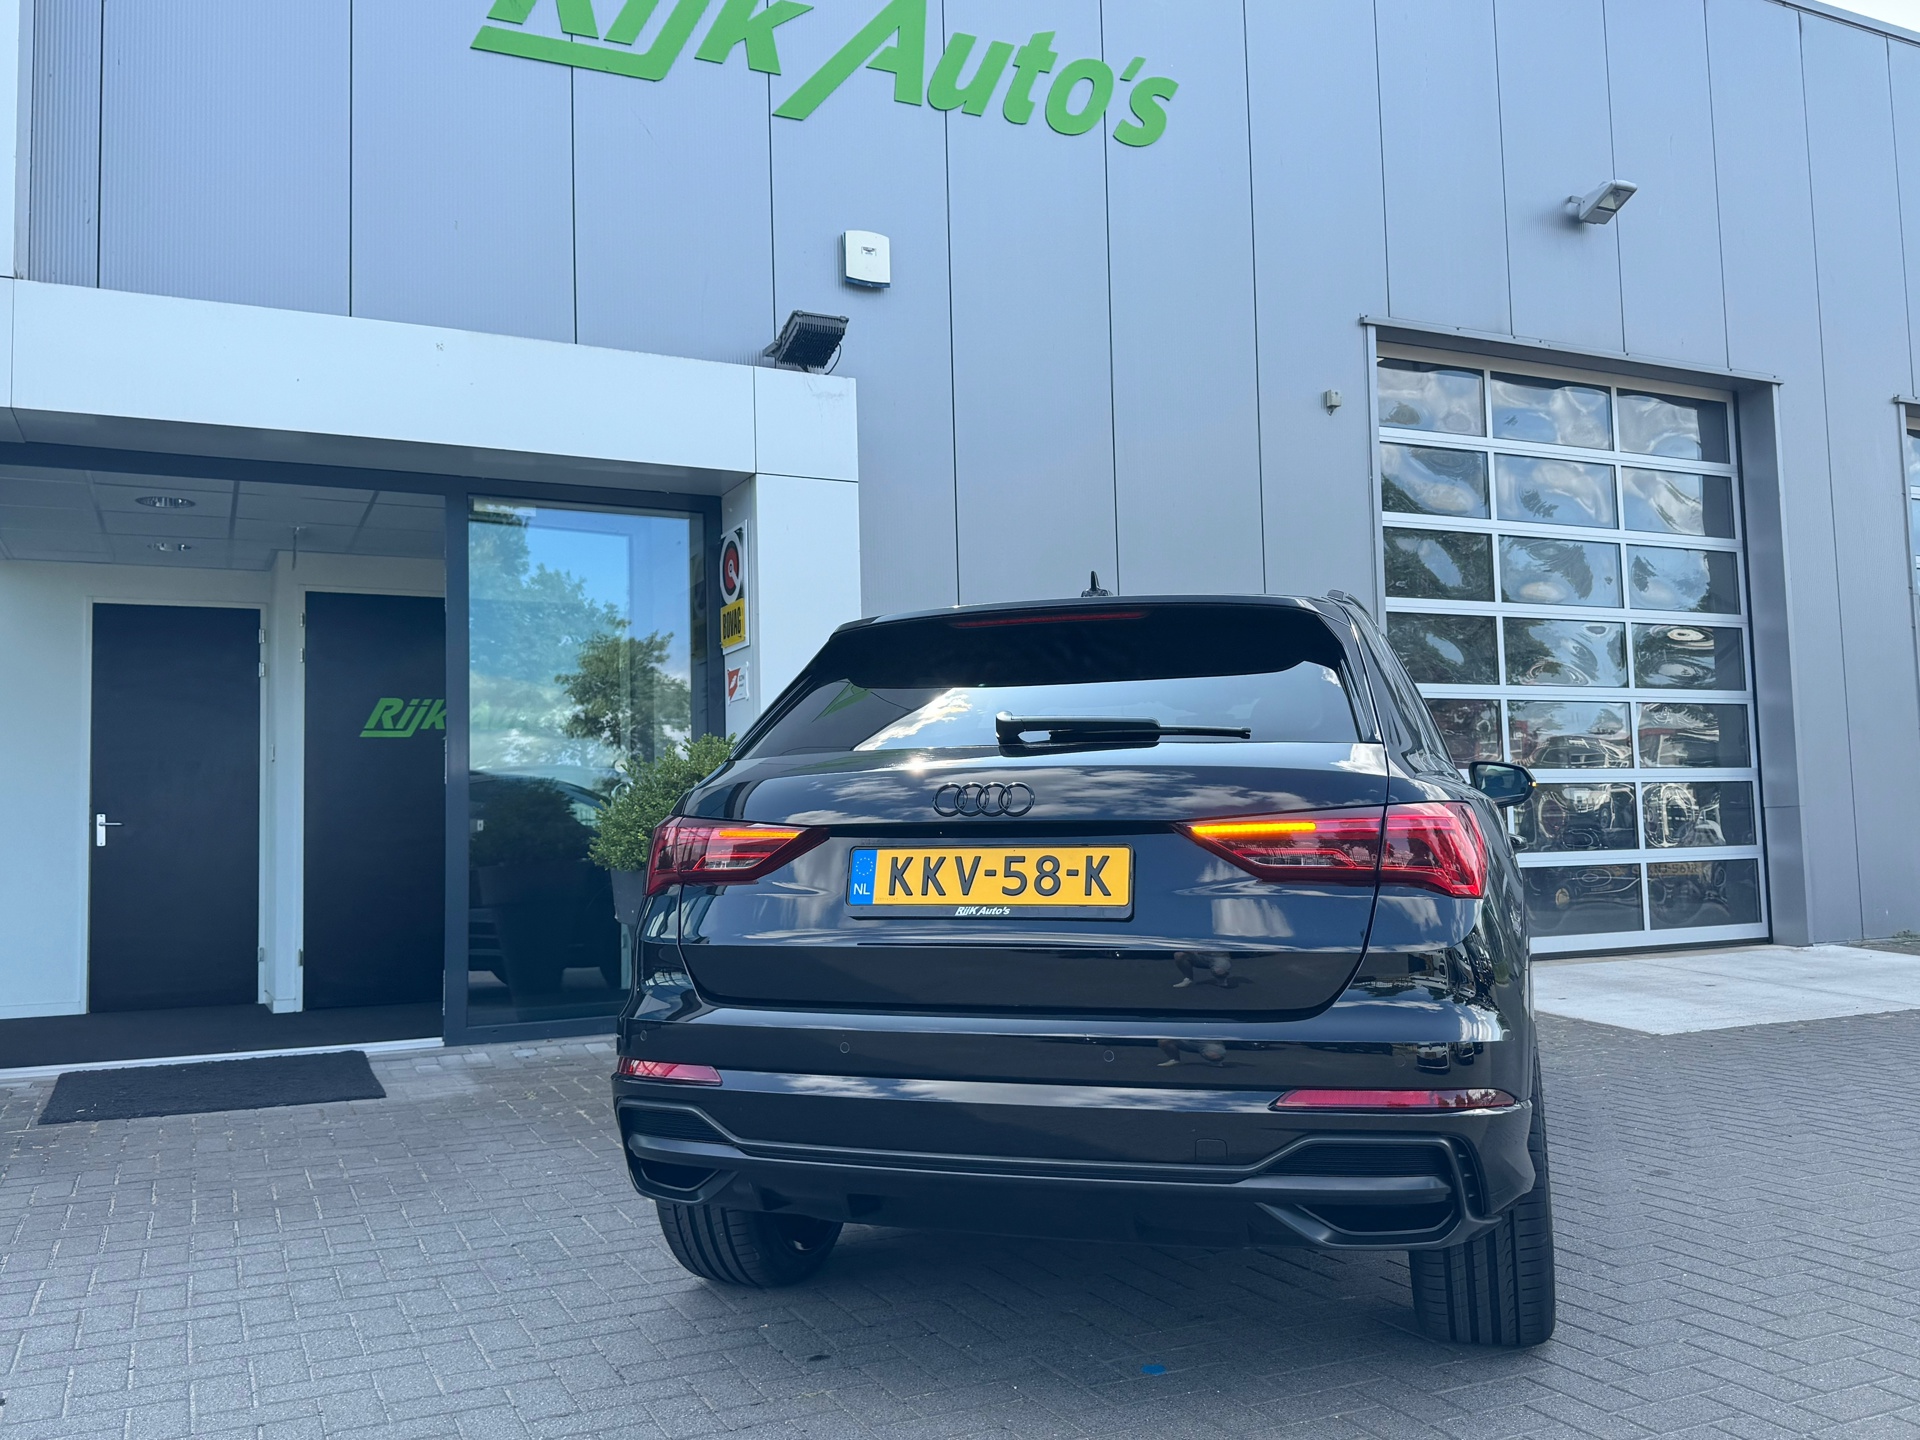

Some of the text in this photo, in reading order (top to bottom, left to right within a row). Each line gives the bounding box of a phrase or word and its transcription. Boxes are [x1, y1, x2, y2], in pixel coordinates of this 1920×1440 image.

[772, 0, 1179, 147] Auto's
[723, 606, 742, 640] BOVAG
[853, 883, 871, 896] NL
[888, 855, 1112, 897] KKV-58-K
[976, 906, 1011, 916] Auto's
